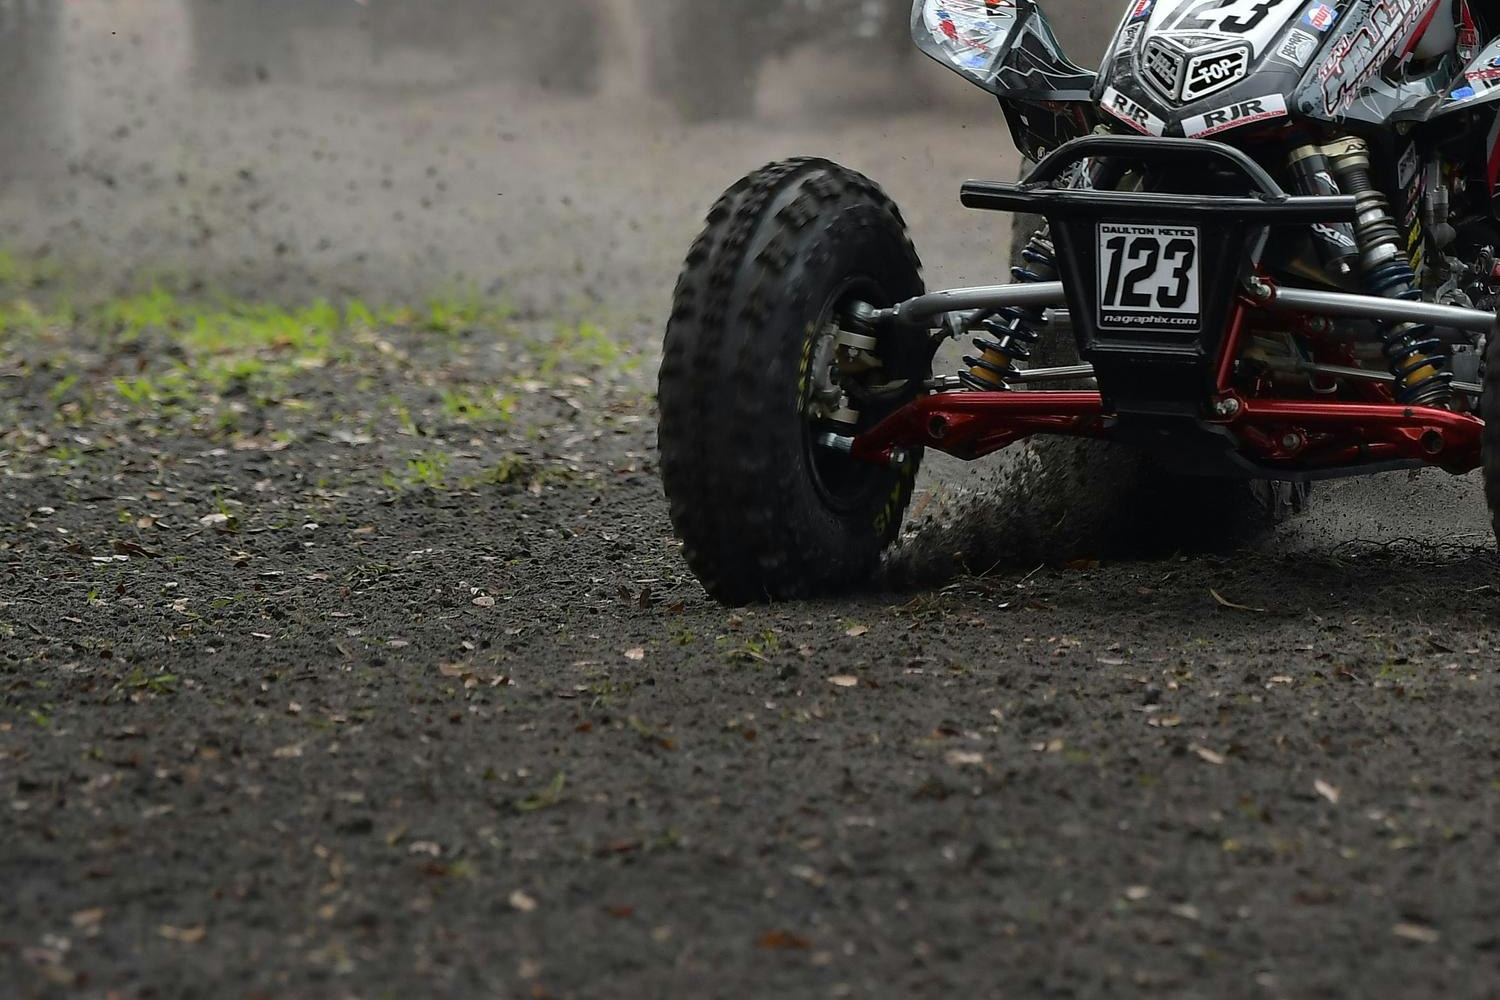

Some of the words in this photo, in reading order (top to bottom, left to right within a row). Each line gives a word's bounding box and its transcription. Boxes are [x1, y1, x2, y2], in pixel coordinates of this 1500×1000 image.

[1198, 58, 1234, 84] TOP
[1111, 93, 1150, 128] RJR
[1203, 99, 1266, 129] RJR
[1102, 226, 1154, 235] DAULTON
[1158, 228, 1195, 236] KEYES
[1103, 236, 1196, 309] 123
